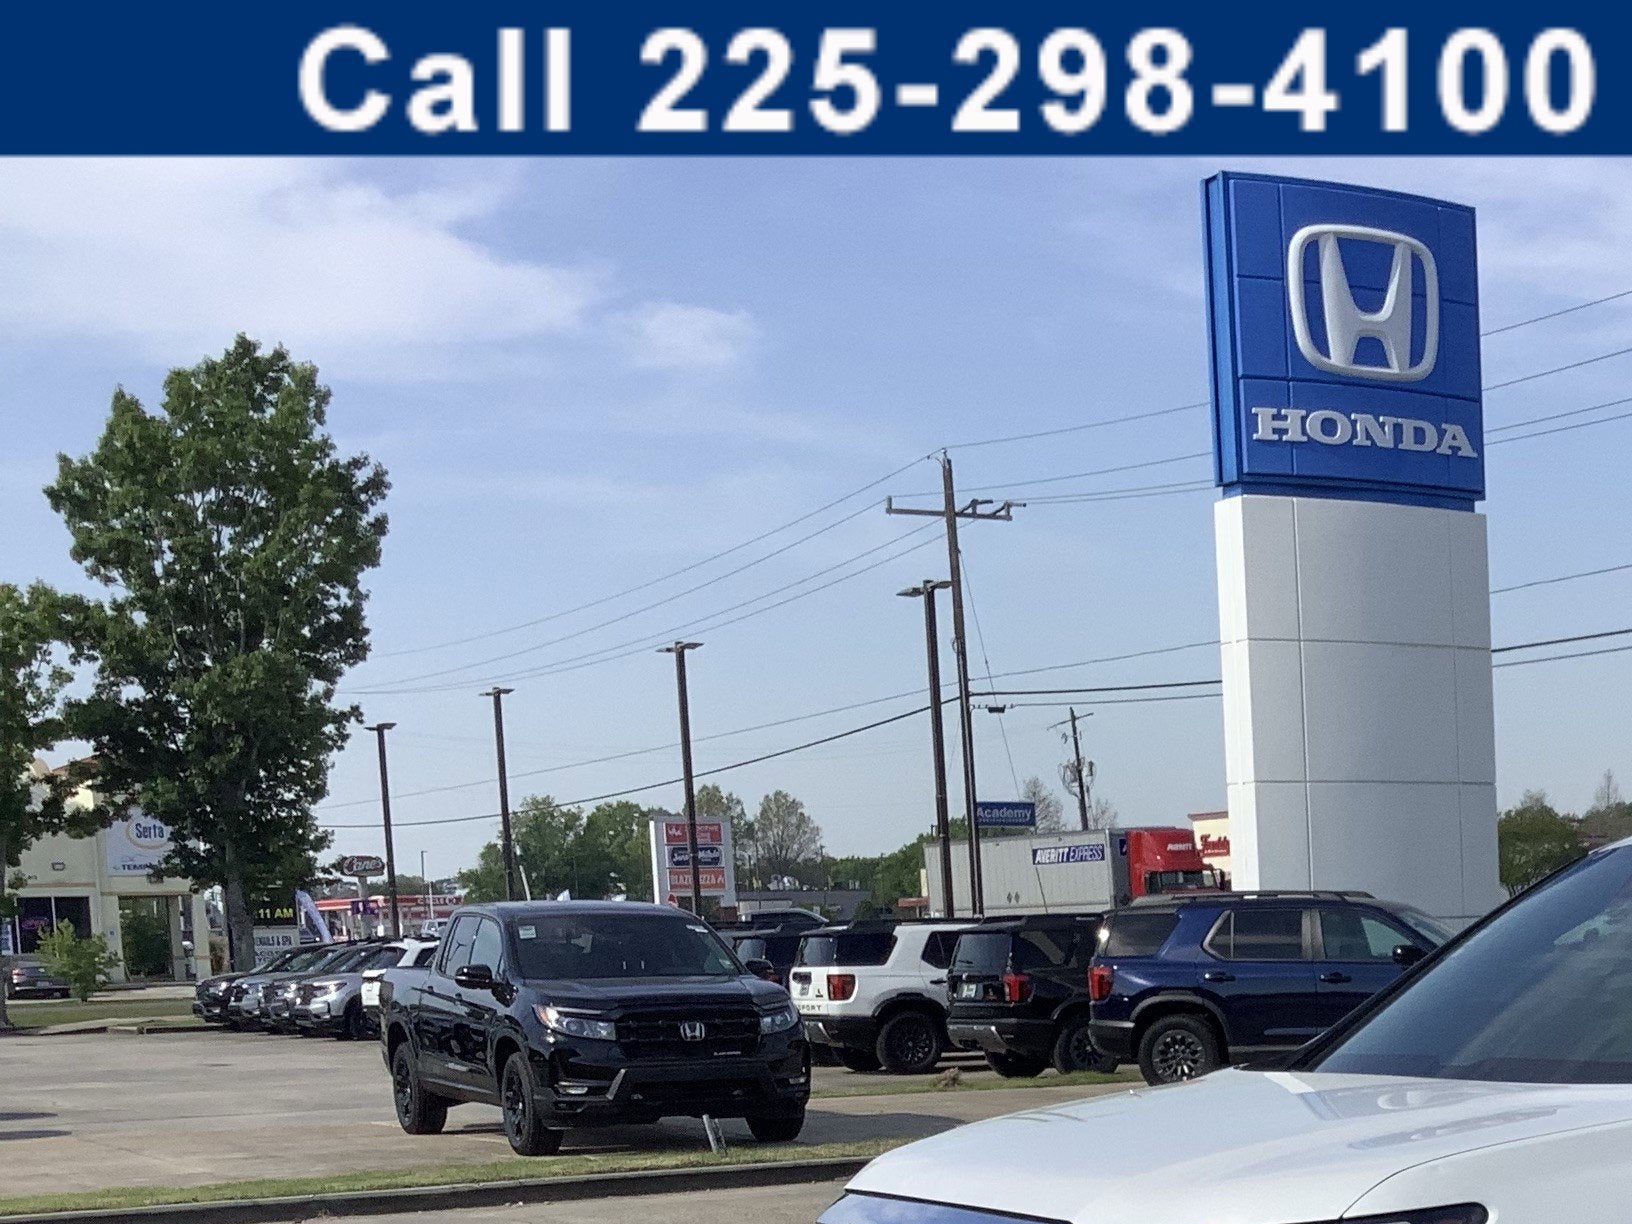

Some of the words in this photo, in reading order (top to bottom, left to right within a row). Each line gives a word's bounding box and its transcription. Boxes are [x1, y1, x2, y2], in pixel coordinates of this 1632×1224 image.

[1251, 407, 1479, 458] HONDA
[977, 807, 1032, 821] Academy
[135, 823, 165, 839] Serta
[1035, 847, 1069, 864] AVERITT
[1069, 845, 1103, 861] EXPRESS
[274, 908, 293, 918] AM
